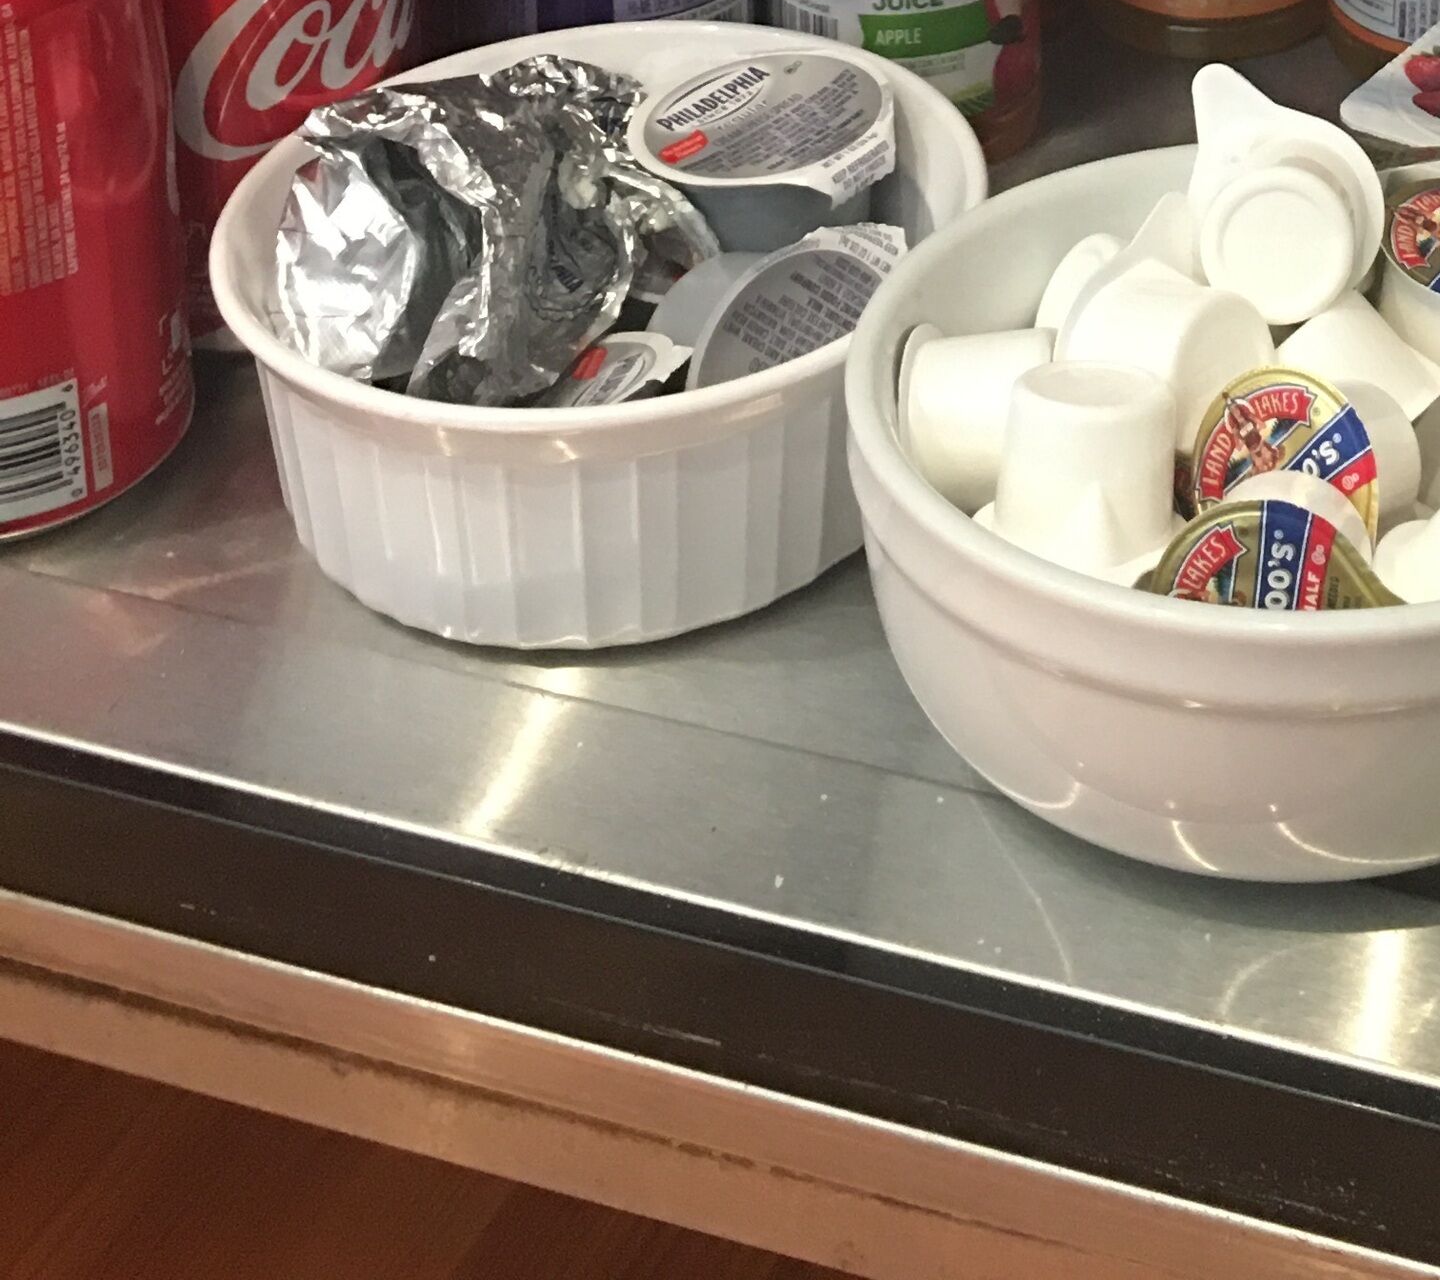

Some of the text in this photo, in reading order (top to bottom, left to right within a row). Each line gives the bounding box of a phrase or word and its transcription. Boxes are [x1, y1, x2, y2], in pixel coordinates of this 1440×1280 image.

[876, 28, 922, 45] APPLE
[656, 66, 770, 132] PHILADELPHIA
[1255, 391, 1299, 418] LAKES
[1202, 433, 1232, 486] LAND
[1183, 536, 1226, 590] LAKES
